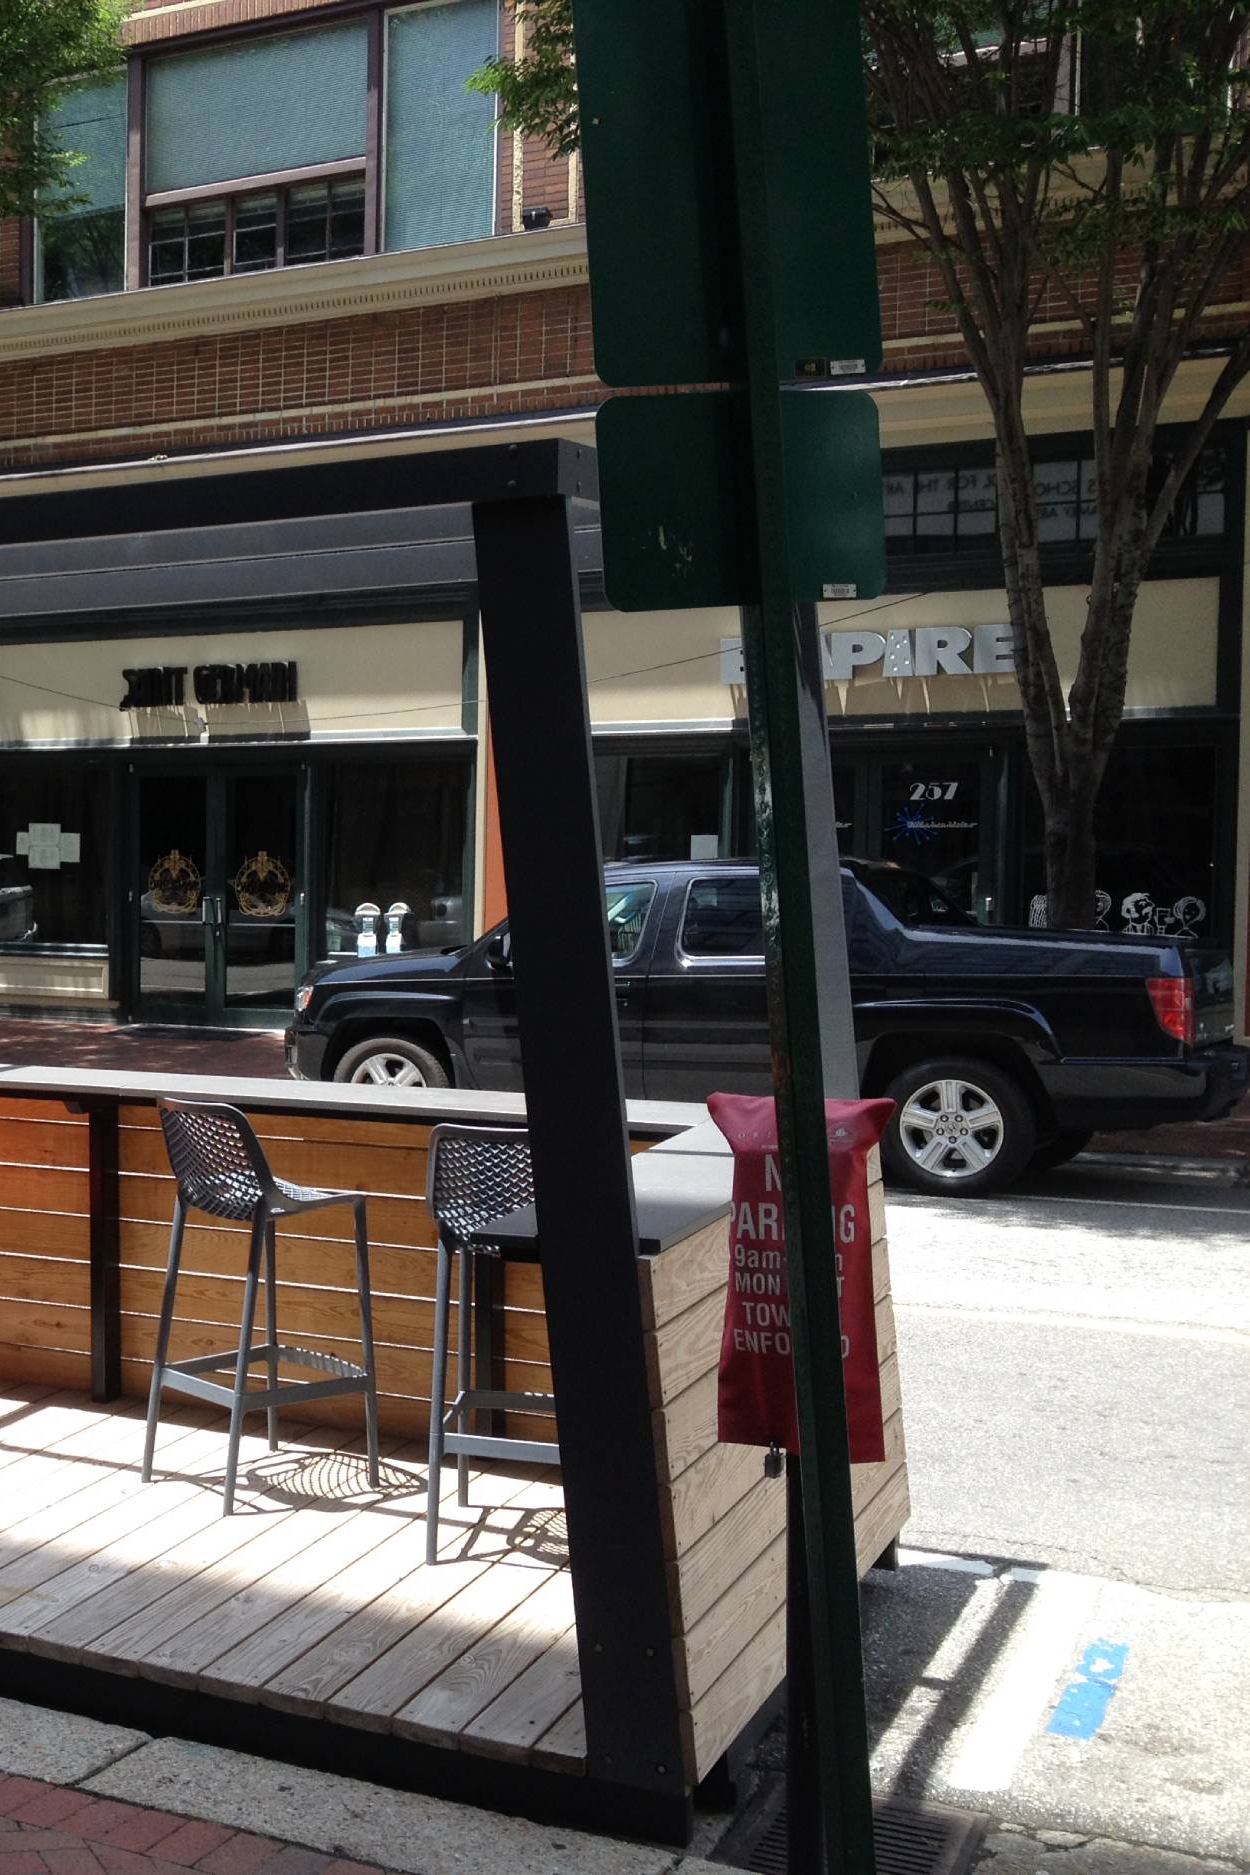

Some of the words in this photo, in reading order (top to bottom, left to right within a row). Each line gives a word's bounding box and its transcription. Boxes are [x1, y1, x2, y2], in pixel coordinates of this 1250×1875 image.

[719, 623, 1015, 684] EPIRE
[910, 782, 958, 800] 257
[729, 1199, 855, 1244] PARG
[733, 1328, 850, 1359] ENFOD
